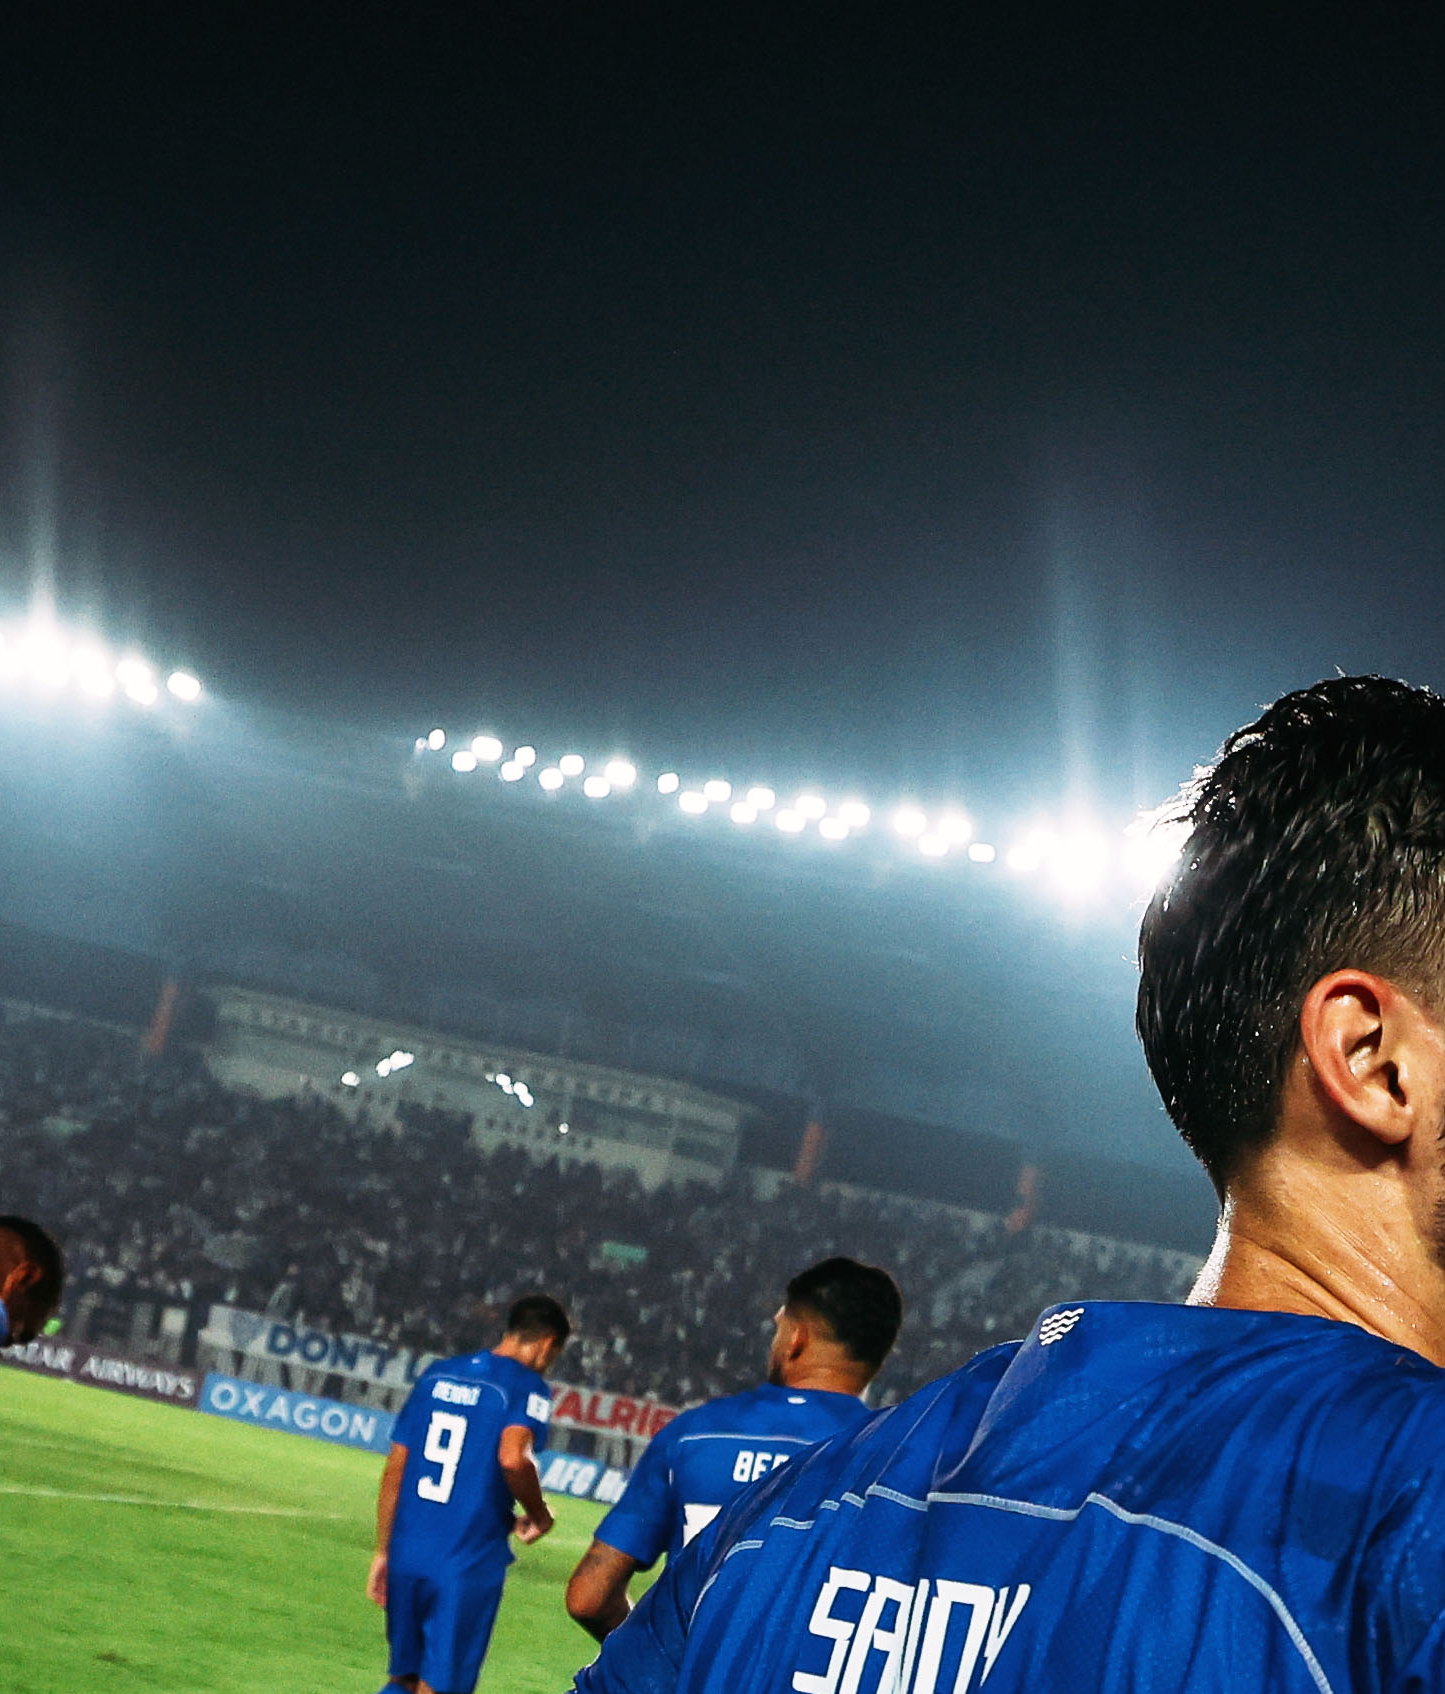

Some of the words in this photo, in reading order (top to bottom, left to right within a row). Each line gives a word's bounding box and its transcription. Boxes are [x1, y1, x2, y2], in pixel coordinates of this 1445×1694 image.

[0, 1341, 77, 1373] ATAR
[79, 1355, 196, 1399] AIRWAYS
[210, 1381, 377, 1443] OXAGON
[417, 1411, 468, 1504] 9
